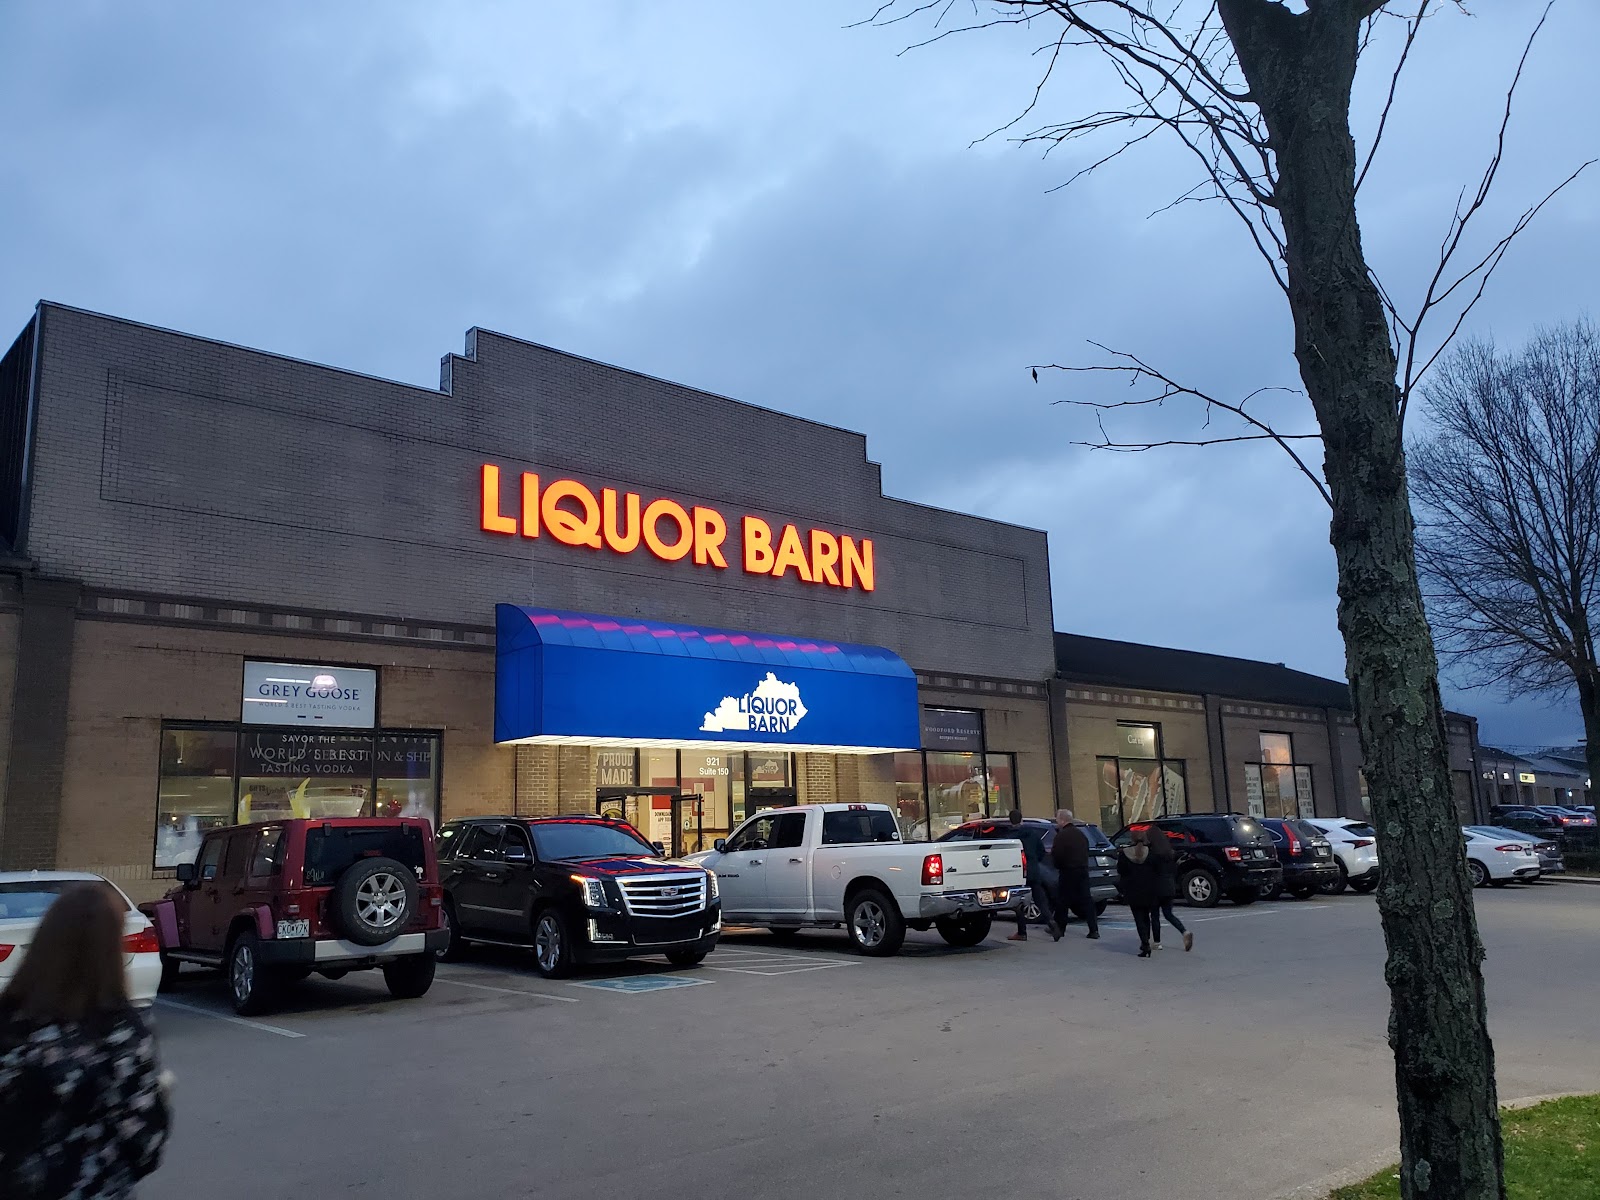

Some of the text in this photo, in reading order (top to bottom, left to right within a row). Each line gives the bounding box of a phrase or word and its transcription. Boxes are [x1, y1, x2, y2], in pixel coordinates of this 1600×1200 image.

[480, 463, 875, 592] LIQUOR BARN
[259, 684, 360, 700] GREY GOOSE
[738, 696, 798, 716] LIQUOR
[748, 715, 790, 733] BARN
[282, 734, 315, 743] SAVOR
[318, 735, 336, 744] THE
[329, 749, 364, 761] BEST
[602, 752, 633, 767] PROUD
[706, 756, 720, 766] 921
[260, 763, 354, 774] TASTING VODKA
[699, 767, 729, 776] Suite 150
[601, 768, 633, 785] MADE
